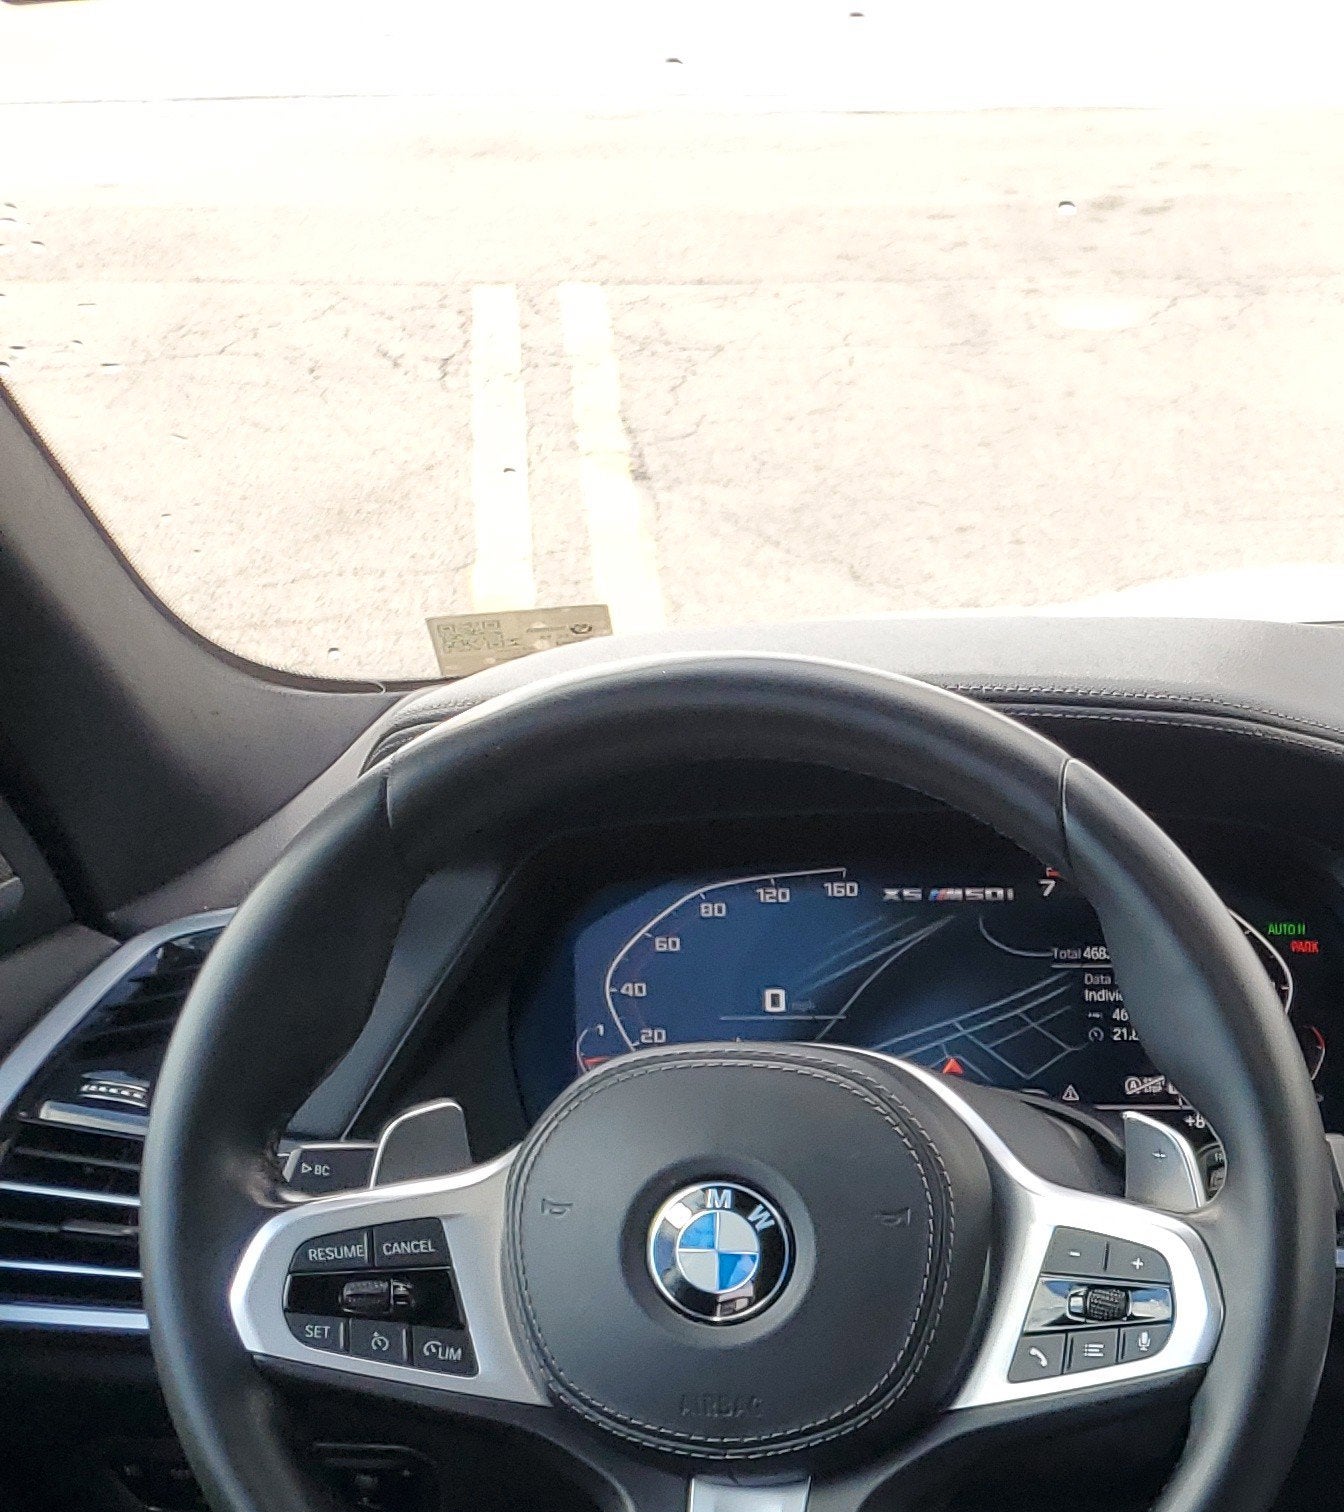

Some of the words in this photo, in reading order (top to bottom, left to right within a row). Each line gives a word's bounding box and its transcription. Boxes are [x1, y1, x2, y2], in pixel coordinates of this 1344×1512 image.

[756, 887, 790, 903] 120
[824, 882, 859, 898] 160
[883, 888, 922, 900] X5
[1038, 879, 1056, 897] 7
[700, 903, 726, 917] 80
[1268, 923, 1296, 935] AUTO
[655, 937, 681, 951] 60
[1053, 946, 1081, 960] Total
[1083, 946, 1111, 961] 468.
[1084, 973, 1112, 985] Data
[620, 982, 647, 997] 40
[1084, 990, 1124, 1002] Indivi
[764, 987, 786, 1013] 0
[1112, 1008, 1129, 1021] 46
[640, 1029, 667, 1043] 20
[314, 1163, 330, 1176] BC
[308, 1243, 365, 1261] RESUME
[382, 1238, 436, 1255] CANCEL
[305, 1325, 331, 1340] SET
[437, 1345, 463, 1361] LIM
